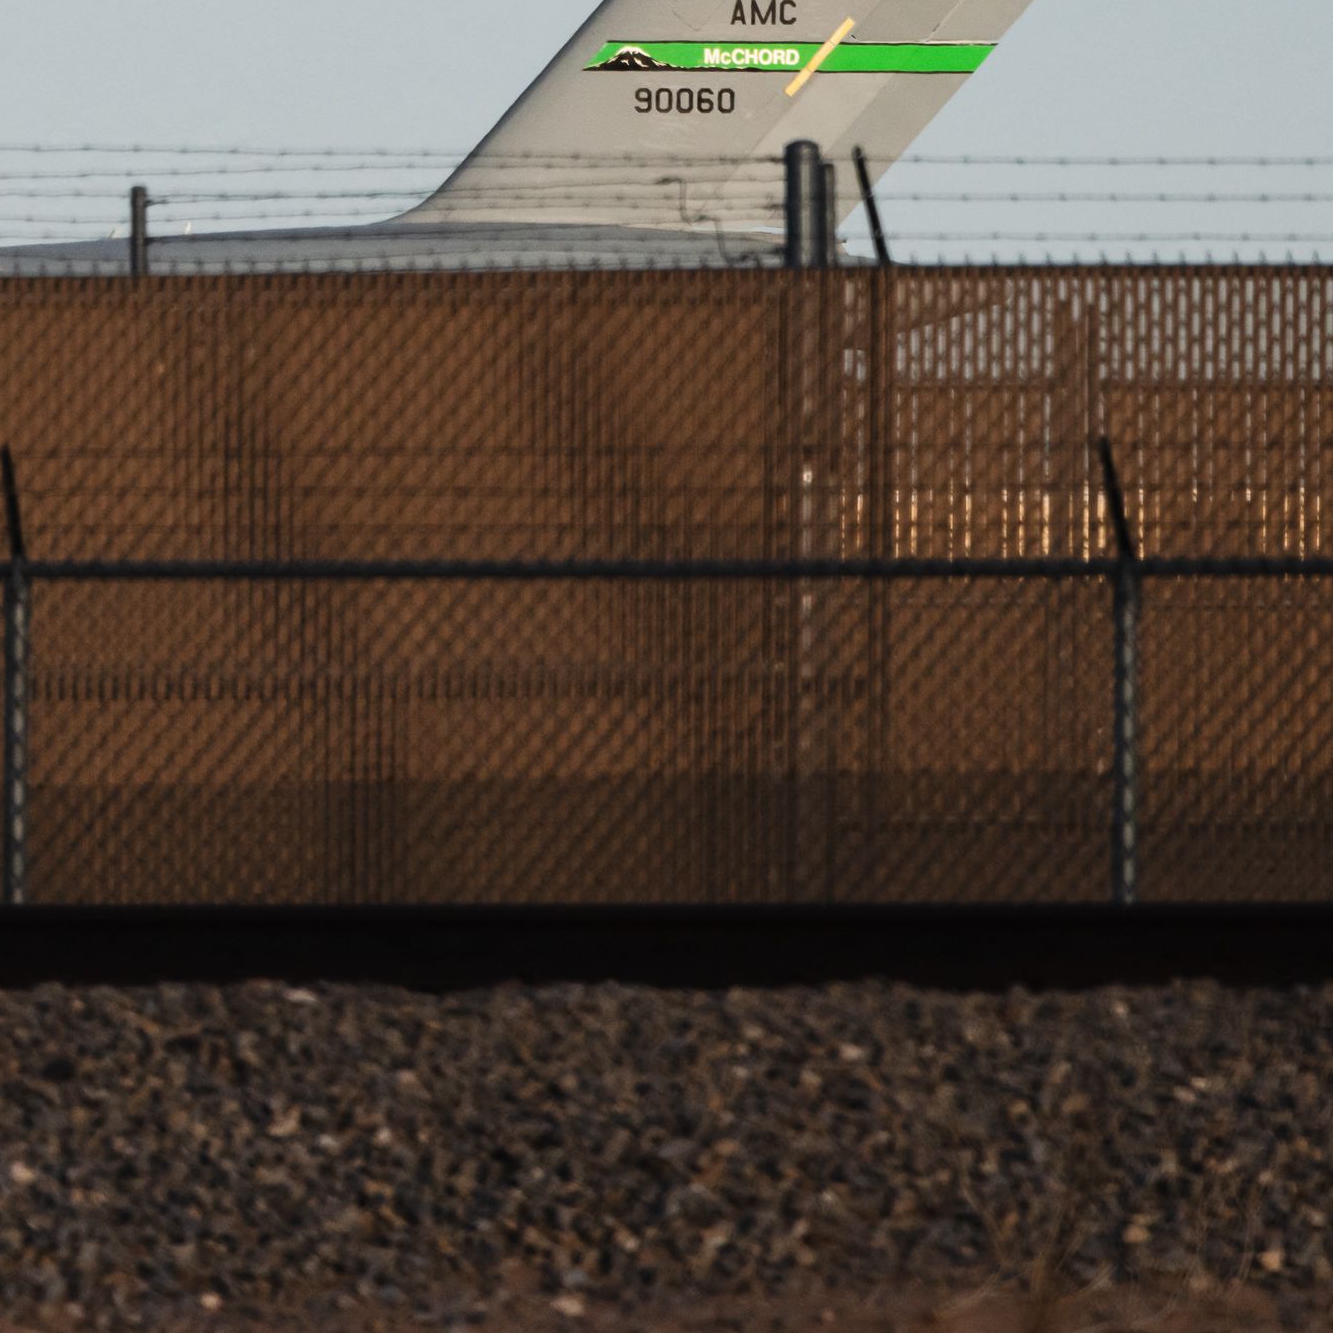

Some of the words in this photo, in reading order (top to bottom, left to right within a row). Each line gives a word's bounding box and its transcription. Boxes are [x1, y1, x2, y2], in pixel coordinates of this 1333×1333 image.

[730, 0, 798, 25] AMC
[703, 47, 800, 66] McCHORD
[634, 87, 736, 114] 90060
